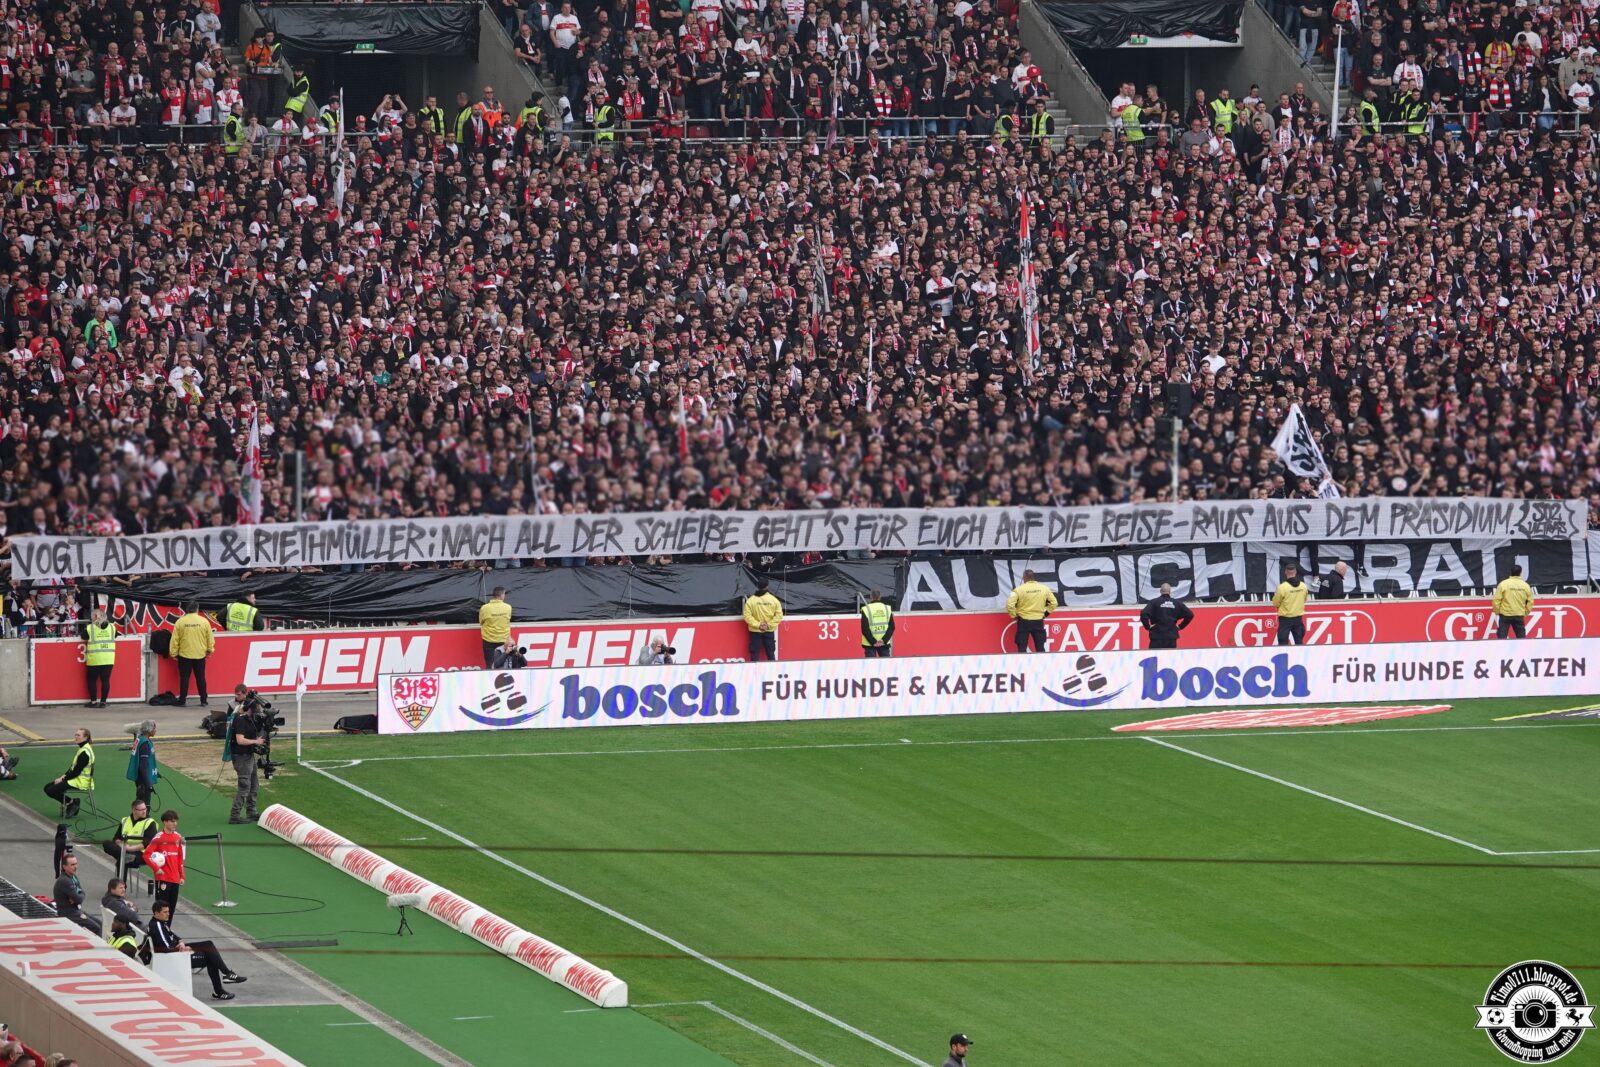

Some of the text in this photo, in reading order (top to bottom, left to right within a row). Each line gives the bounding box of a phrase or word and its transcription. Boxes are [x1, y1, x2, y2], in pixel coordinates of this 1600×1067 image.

[11, 538, 92, 577] VOGT,
[102, 534, 211, 572] ADRION
[220, 530, 251, 565] &
[441, 521, 506, 558] NACH
[514, 521, 562, 554] ALL
[571, 517, 625, 554] DER
[753, 510, 849, 548] GEHT'S
[917, 512, 988, 547] EUCH
[1048, 509, 1091, 544] DIE
[1262, 502, 1312, 538] AUS
[1325, 501, 1380, 537] DEM
[515, 627, 696, 669] EHEIM
[818, 620, 839, 640] 33
[243, 635, 430, 688] EHEIM
[1138, 653, 1311, 701] bosch
[1333, 656, 1586, 683] FÜR HUNDE & KATZEN
[559, 671, 740, 721] bosch
[761, 672, 1026, 701] FÜR HUNDE & KATZEN
[16, 957, 288, 1067] STUTTGAR
